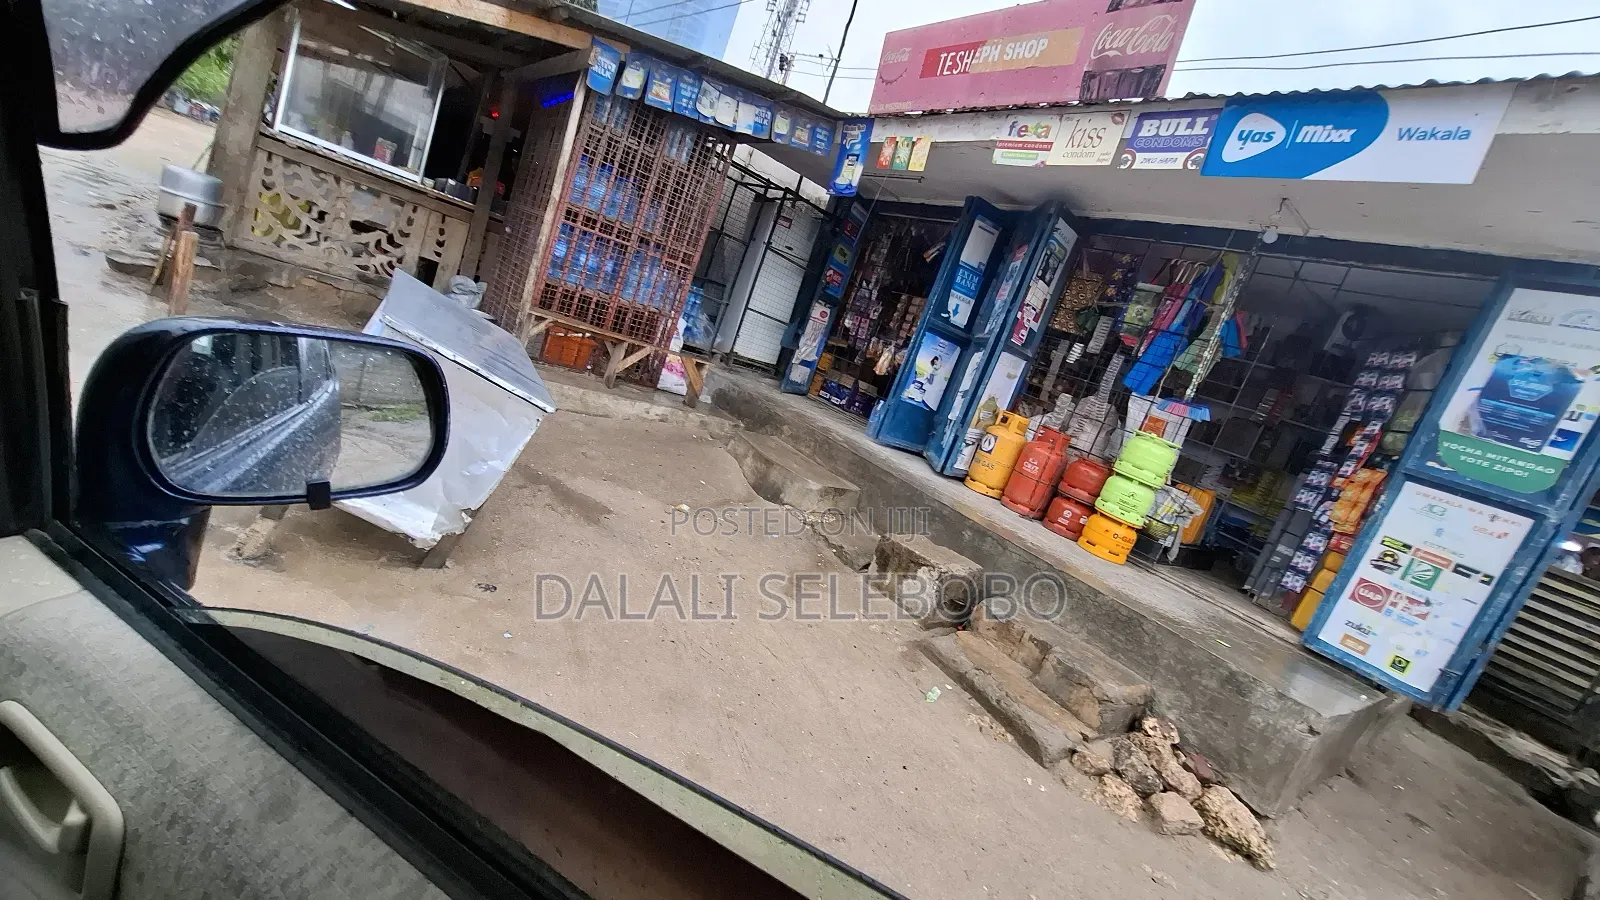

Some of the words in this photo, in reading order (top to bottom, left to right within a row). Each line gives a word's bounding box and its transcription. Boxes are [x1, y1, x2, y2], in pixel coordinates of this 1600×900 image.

[1091, 14, 1178, 60] Coca-Cola
[1003, 39, 1048, 61] SHOP
[1065, 119, 1106, 149] kiss
[1138, 117, 1209, 136] BULL
[1397, 126, 1472, 142] Wakala
[1134, 136, 1205, 148] CONDOMS
[1062, 148, 1096, 159] condom
[955, 275, 977, 291] BANK
[958, 268, 979, 284] EXIM
[1485, 452, 1556, 474] MITANDAO
[1492, 464, 1529, 478] ZIPO!
